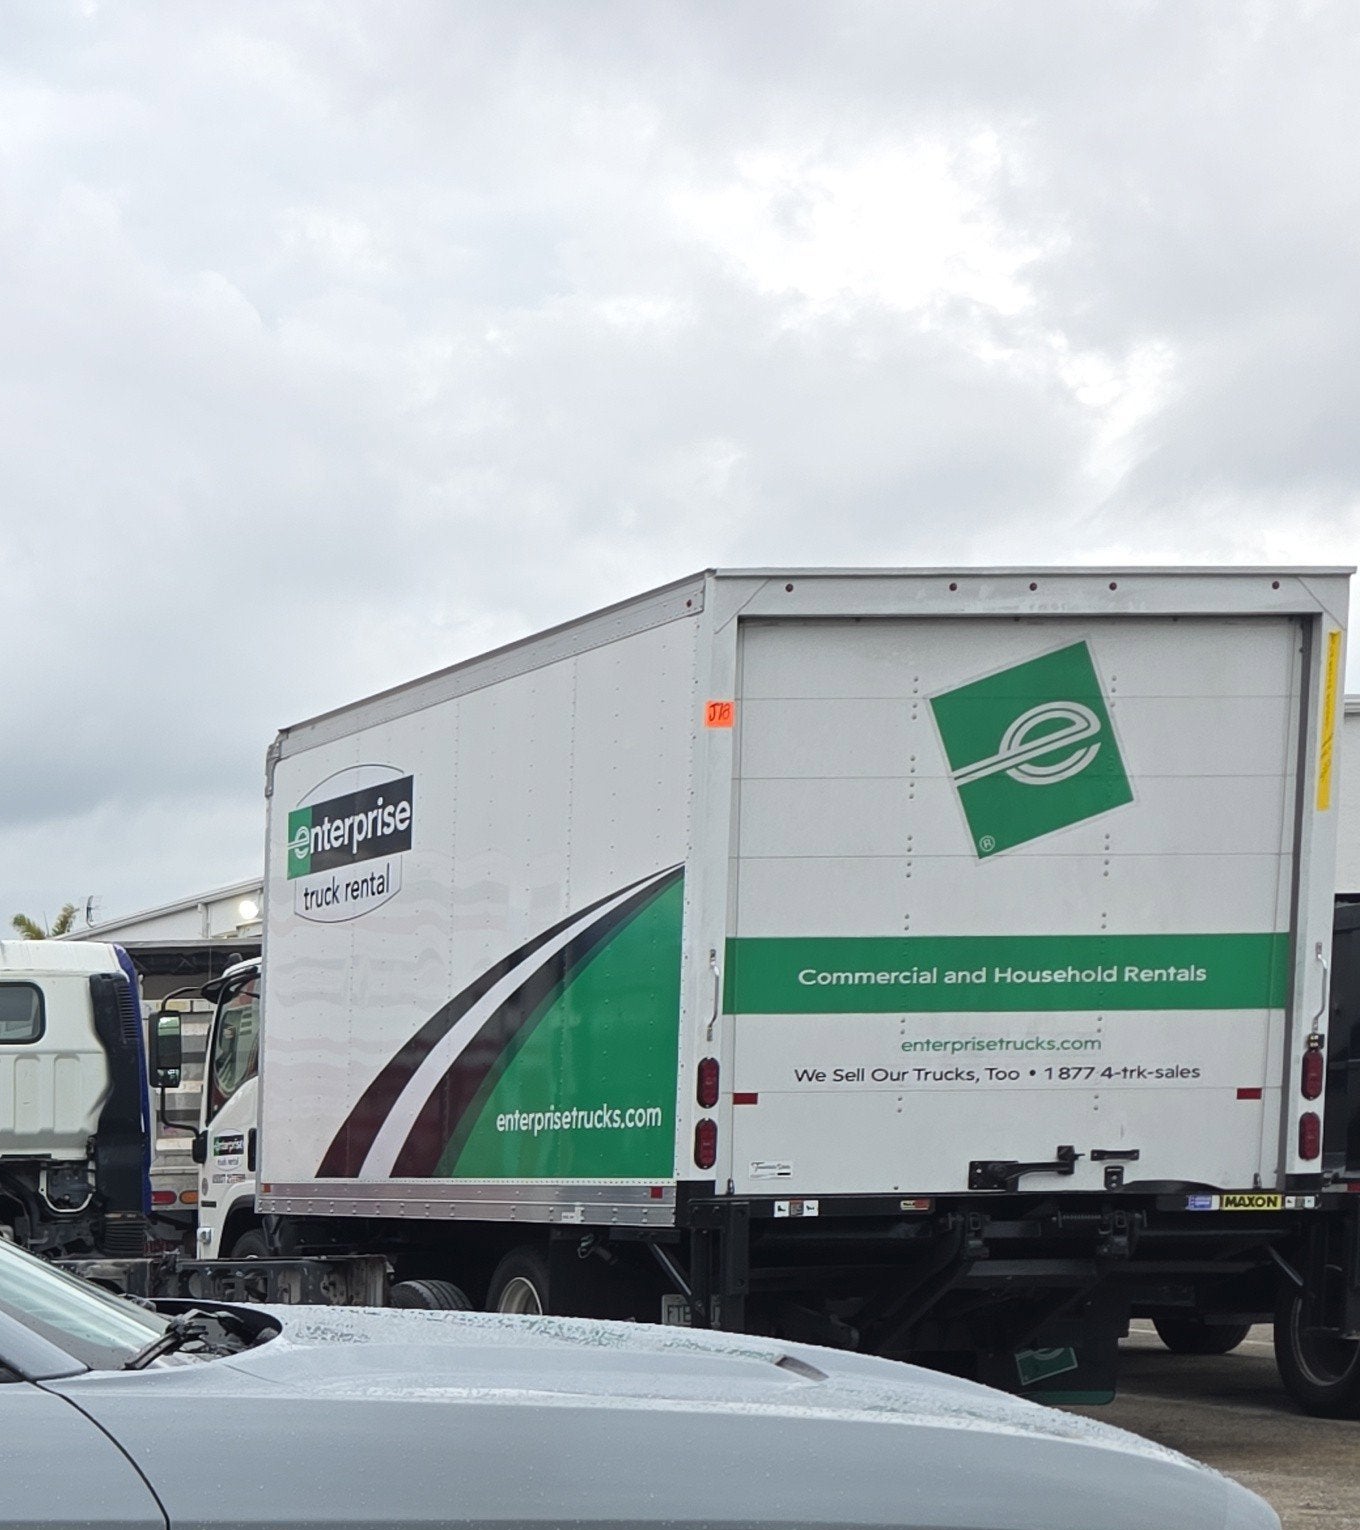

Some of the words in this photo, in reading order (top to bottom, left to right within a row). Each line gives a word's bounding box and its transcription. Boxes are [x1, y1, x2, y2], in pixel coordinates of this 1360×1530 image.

[288, 797, 411, 859] enterprise
[303, 876, 340, 911] truck
[345, 862, 390, 902] rental
[798, 967, 938, 986] Commercial
[943, 967, 987, 985] and
[993, 965, 1118, 984] Household
[1123, 965, 1207, 982] Rentals
[901, 1036, 1102, 1055] enterprisetrucks.com
[795, 1069, 827, 1082] We
[832, 1068, 865, 1082] Sell
[871, 1068, 909, 1082] Our
[913, 1067, 980, 1084] Trucks,
[984, 1067, 1020, 1081] Too
[496, 1103, 662, 1137] enterprisetrucks.com
[1224, 1196, 1278, 1208] MAXON
